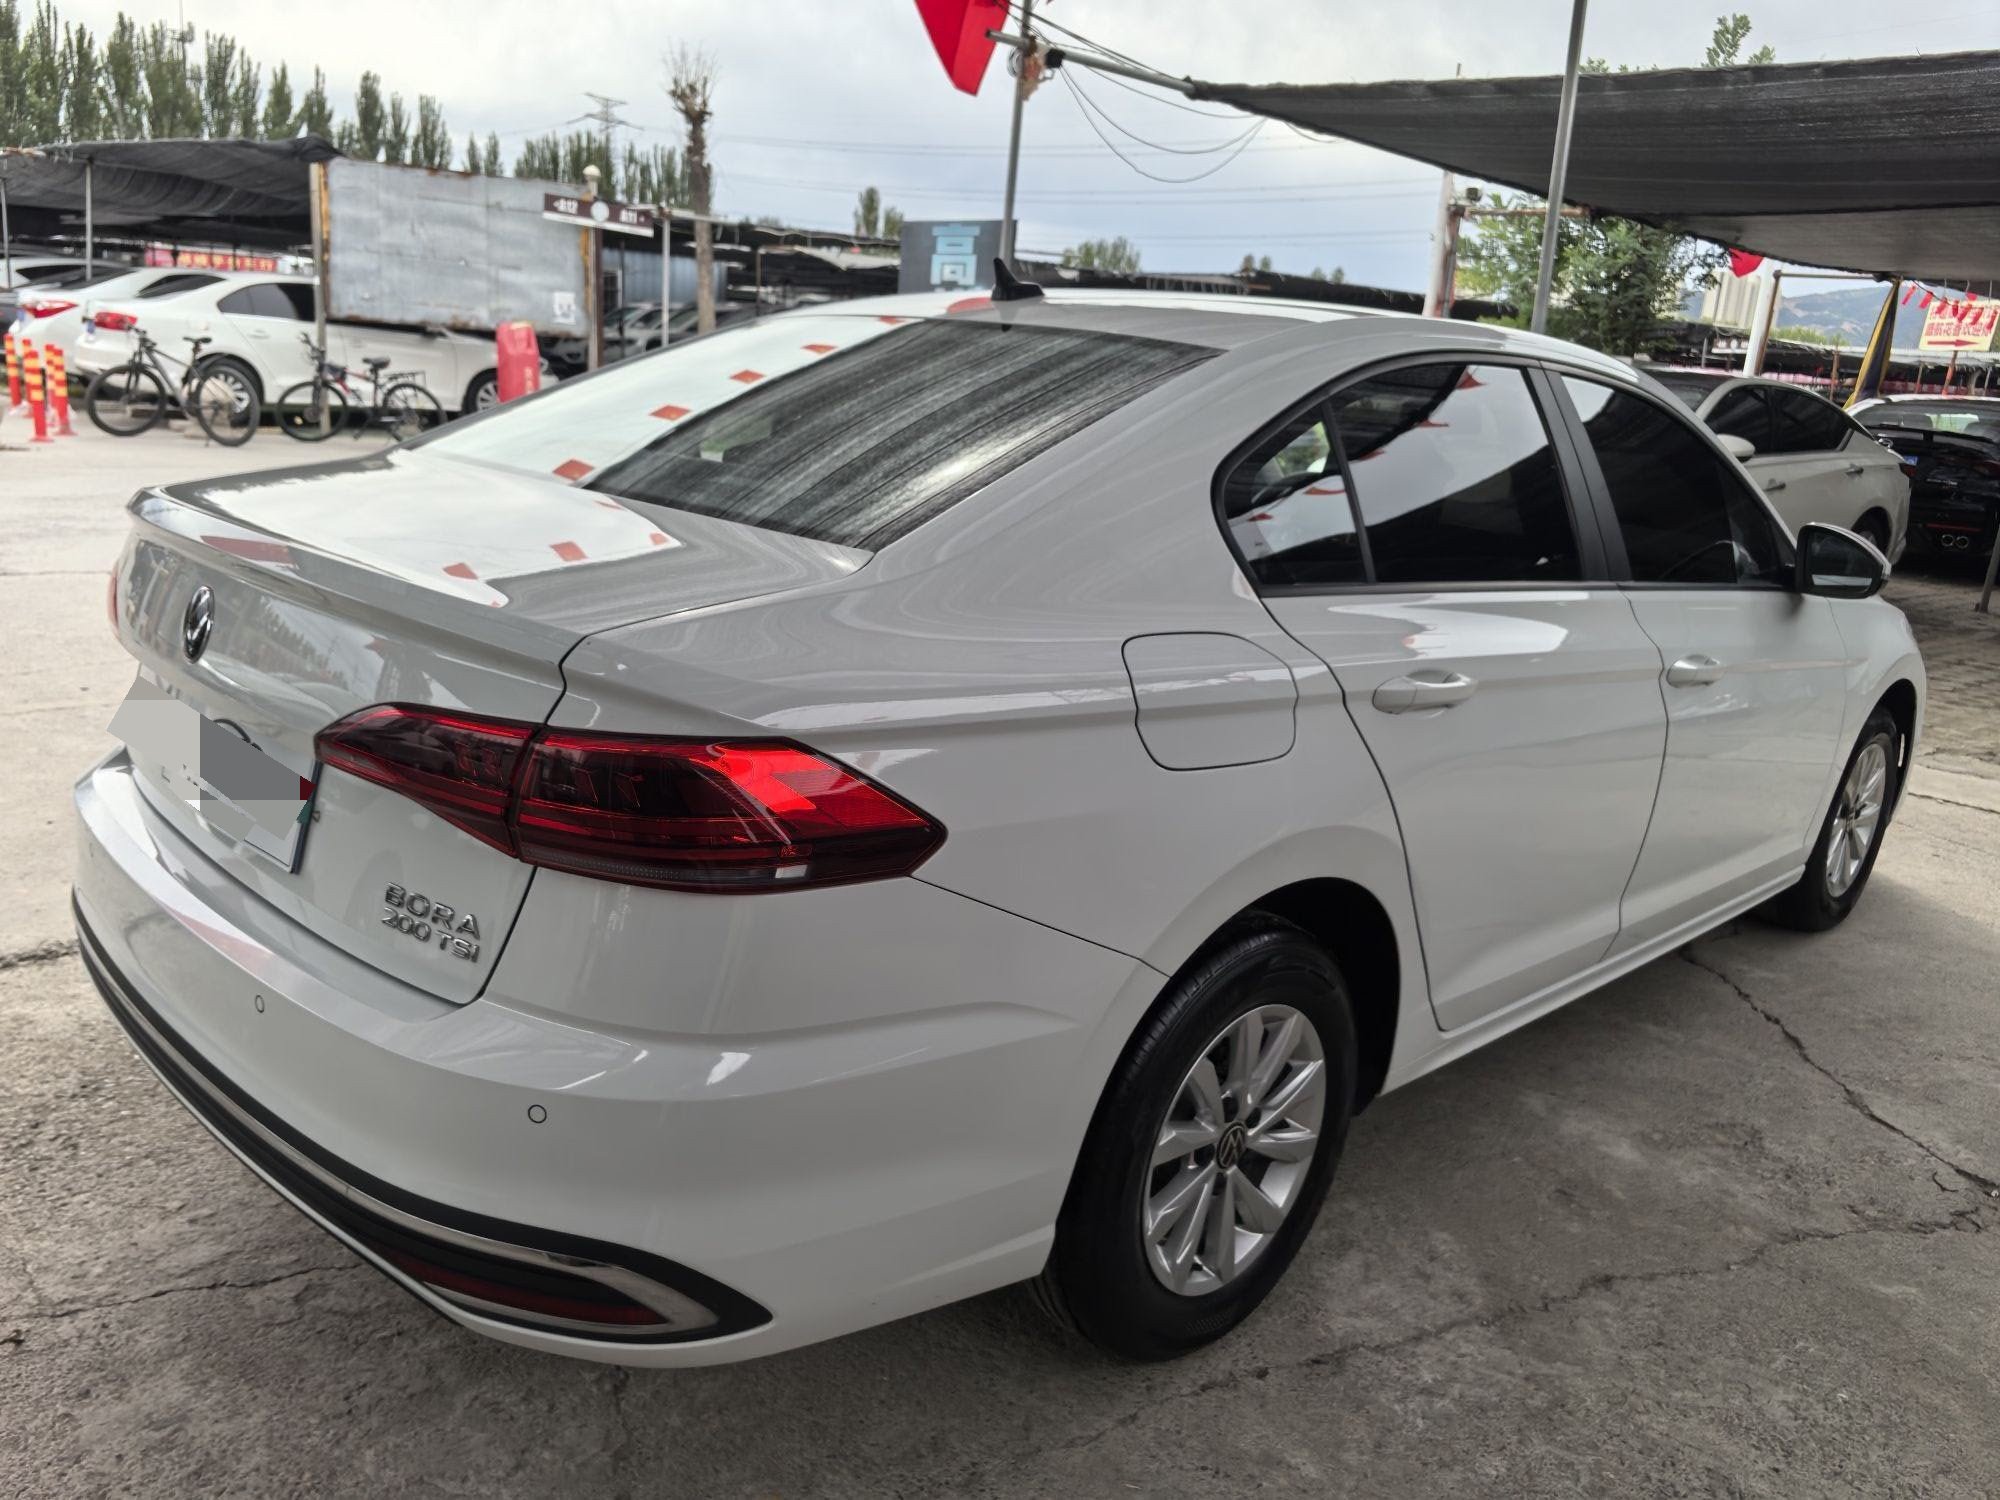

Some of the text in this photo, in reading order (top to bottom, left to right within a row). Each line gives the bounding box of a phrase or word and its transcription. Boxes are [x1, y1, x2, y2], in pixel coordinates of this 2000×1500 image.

[381, 906, 480, 963] 200 TSI
[385, 882, 480, 940] BORA
